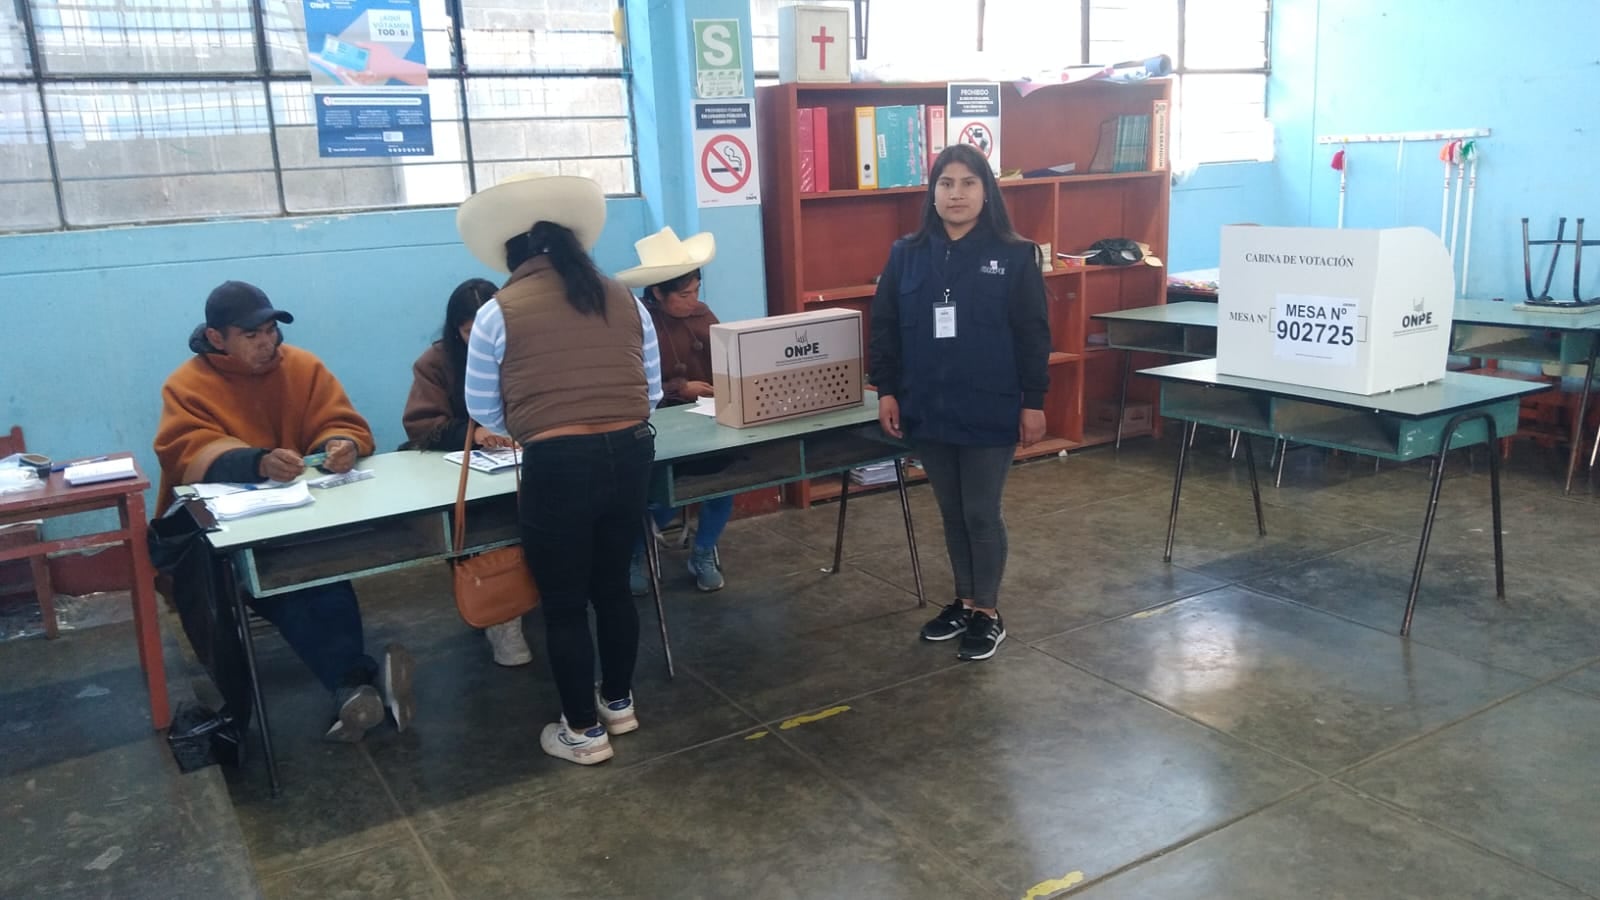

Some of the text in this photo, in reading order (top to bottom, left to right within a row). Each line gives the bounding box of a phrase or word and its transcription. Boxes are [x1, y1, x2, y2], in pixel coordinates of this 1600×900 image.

[703, 24, 733, 66] S
[1245, 253, 1354, 267] CABINA DE VOTACIÓN
[1229, 311, 1255, 323] MESA
[1286, 304, 1327, 320] MESA
[1402, 312, 1432, 328] ONPE
[1277, 320, 1354, 346] 902725
[785, 342, 820, 358] ONPE
